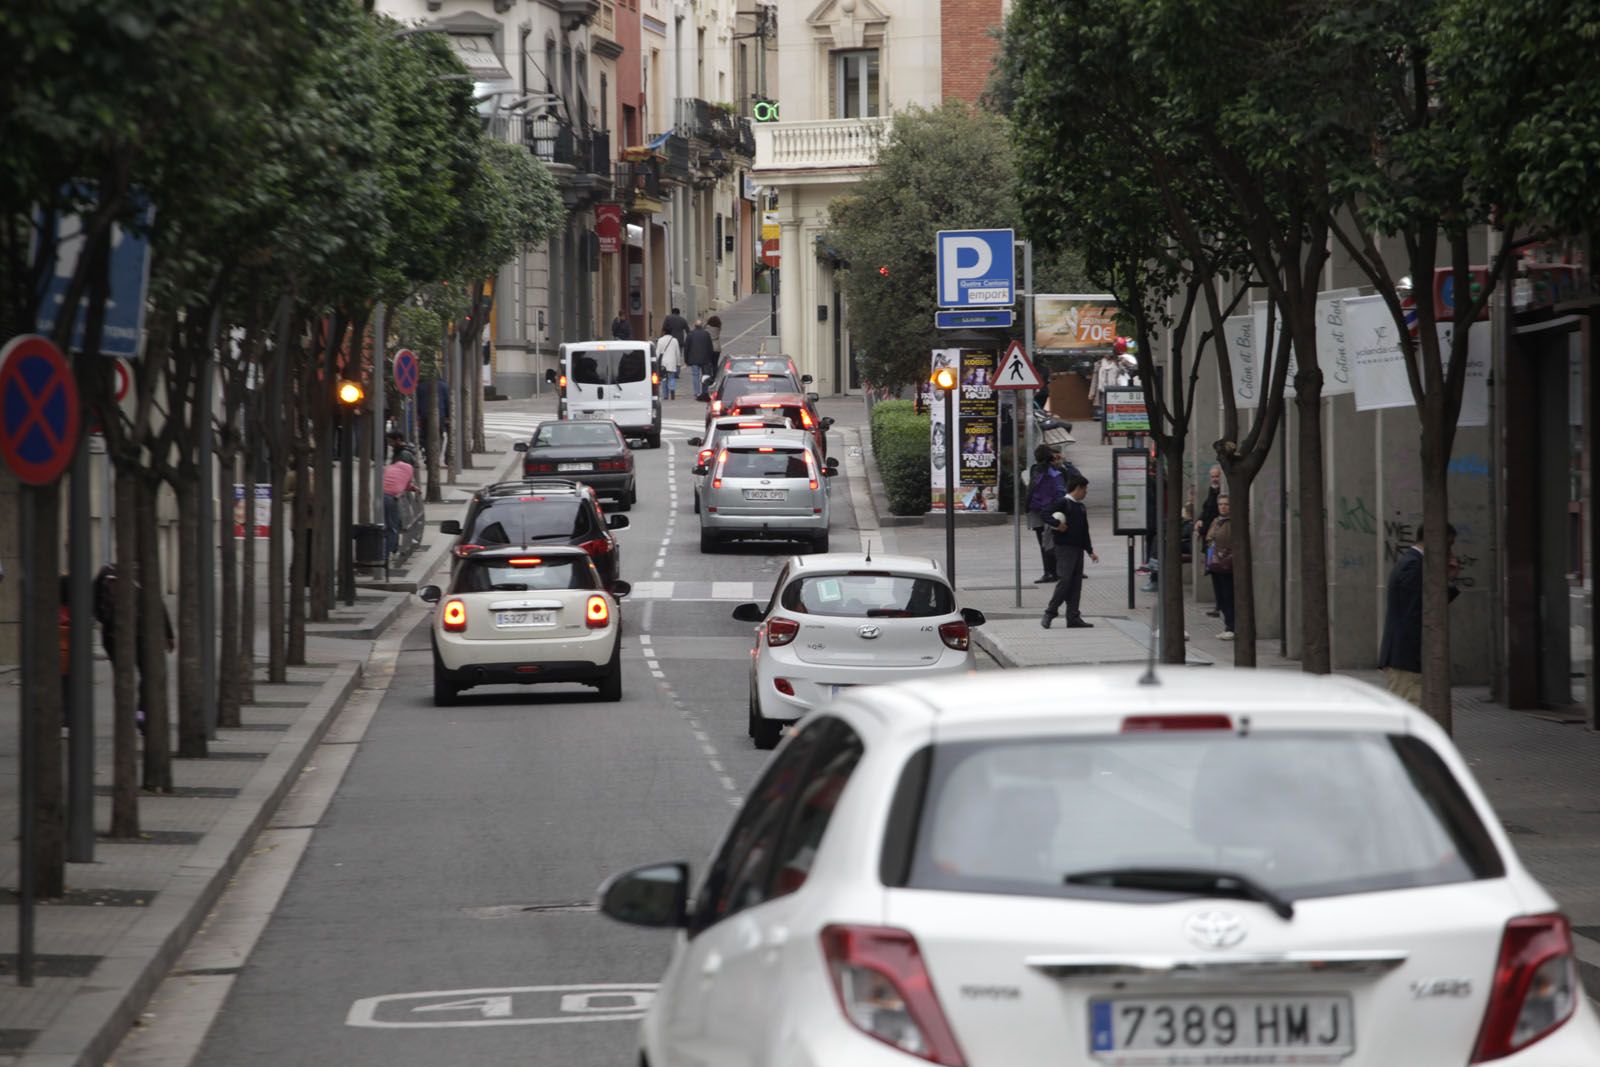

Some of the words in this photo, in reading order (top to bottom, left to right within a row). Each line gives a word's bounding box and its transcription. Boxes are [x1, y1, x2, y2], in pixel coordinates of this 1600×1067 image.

[943, 236, 993, 302] P
[969, 289, 1008, 301] empark
[1080, 325, 1113, 341] 70€
[1121, 1003, 1237, 1047] 7389
[1255, 1002, 1341, 1047] HMJ
